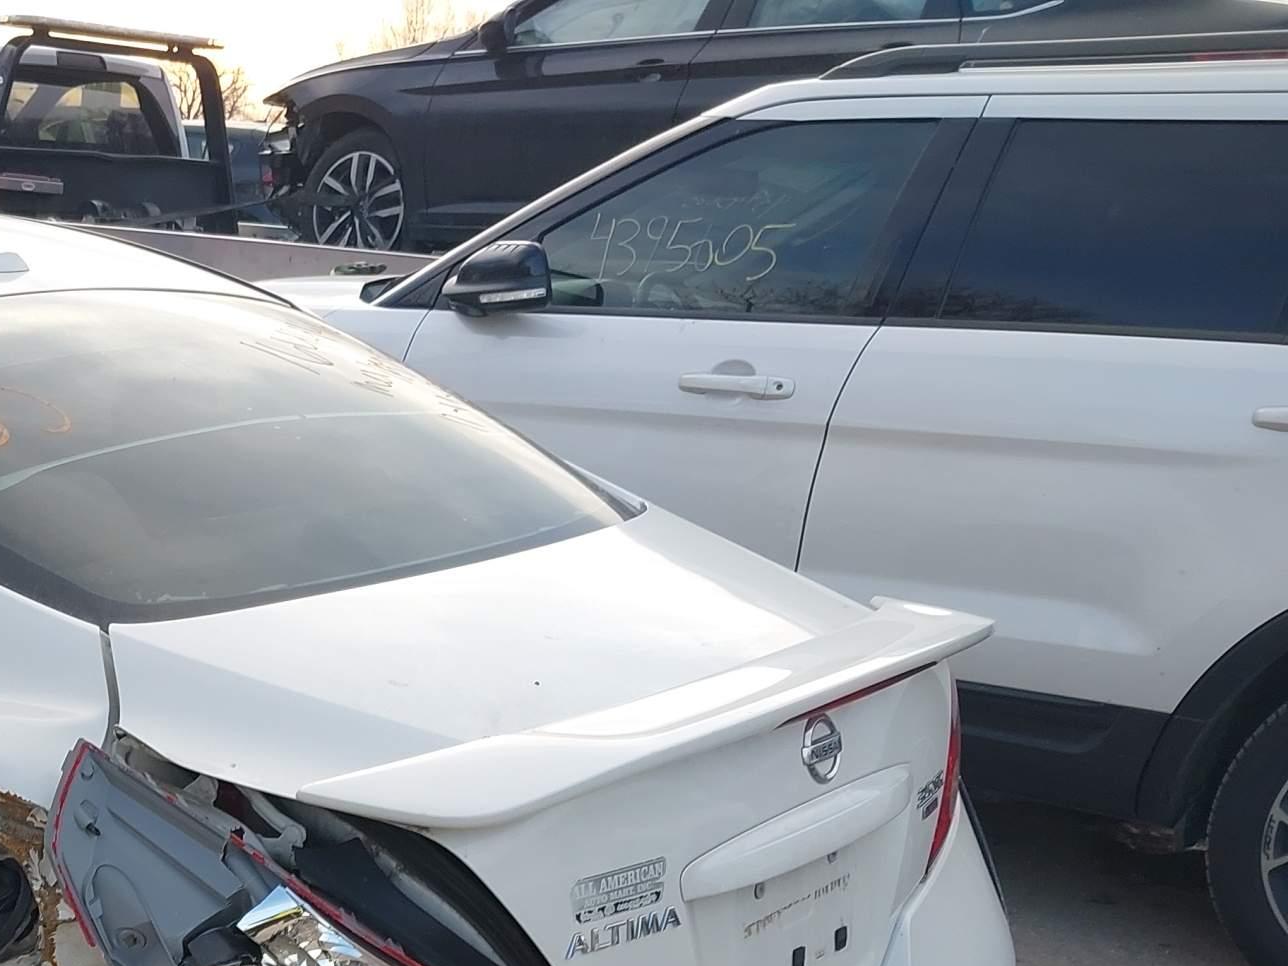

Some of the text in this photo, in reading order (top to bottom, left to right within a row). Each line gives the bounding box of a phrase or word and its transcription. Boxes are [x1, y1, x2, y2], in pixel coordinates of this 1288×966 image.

[590, 212, 797, 282] 4395005
[573, 861, 664, 899] ALL AMERICAN
[584, 893, 609, 908] AUTO
[565, 905, 682, 960] ALTIMA
